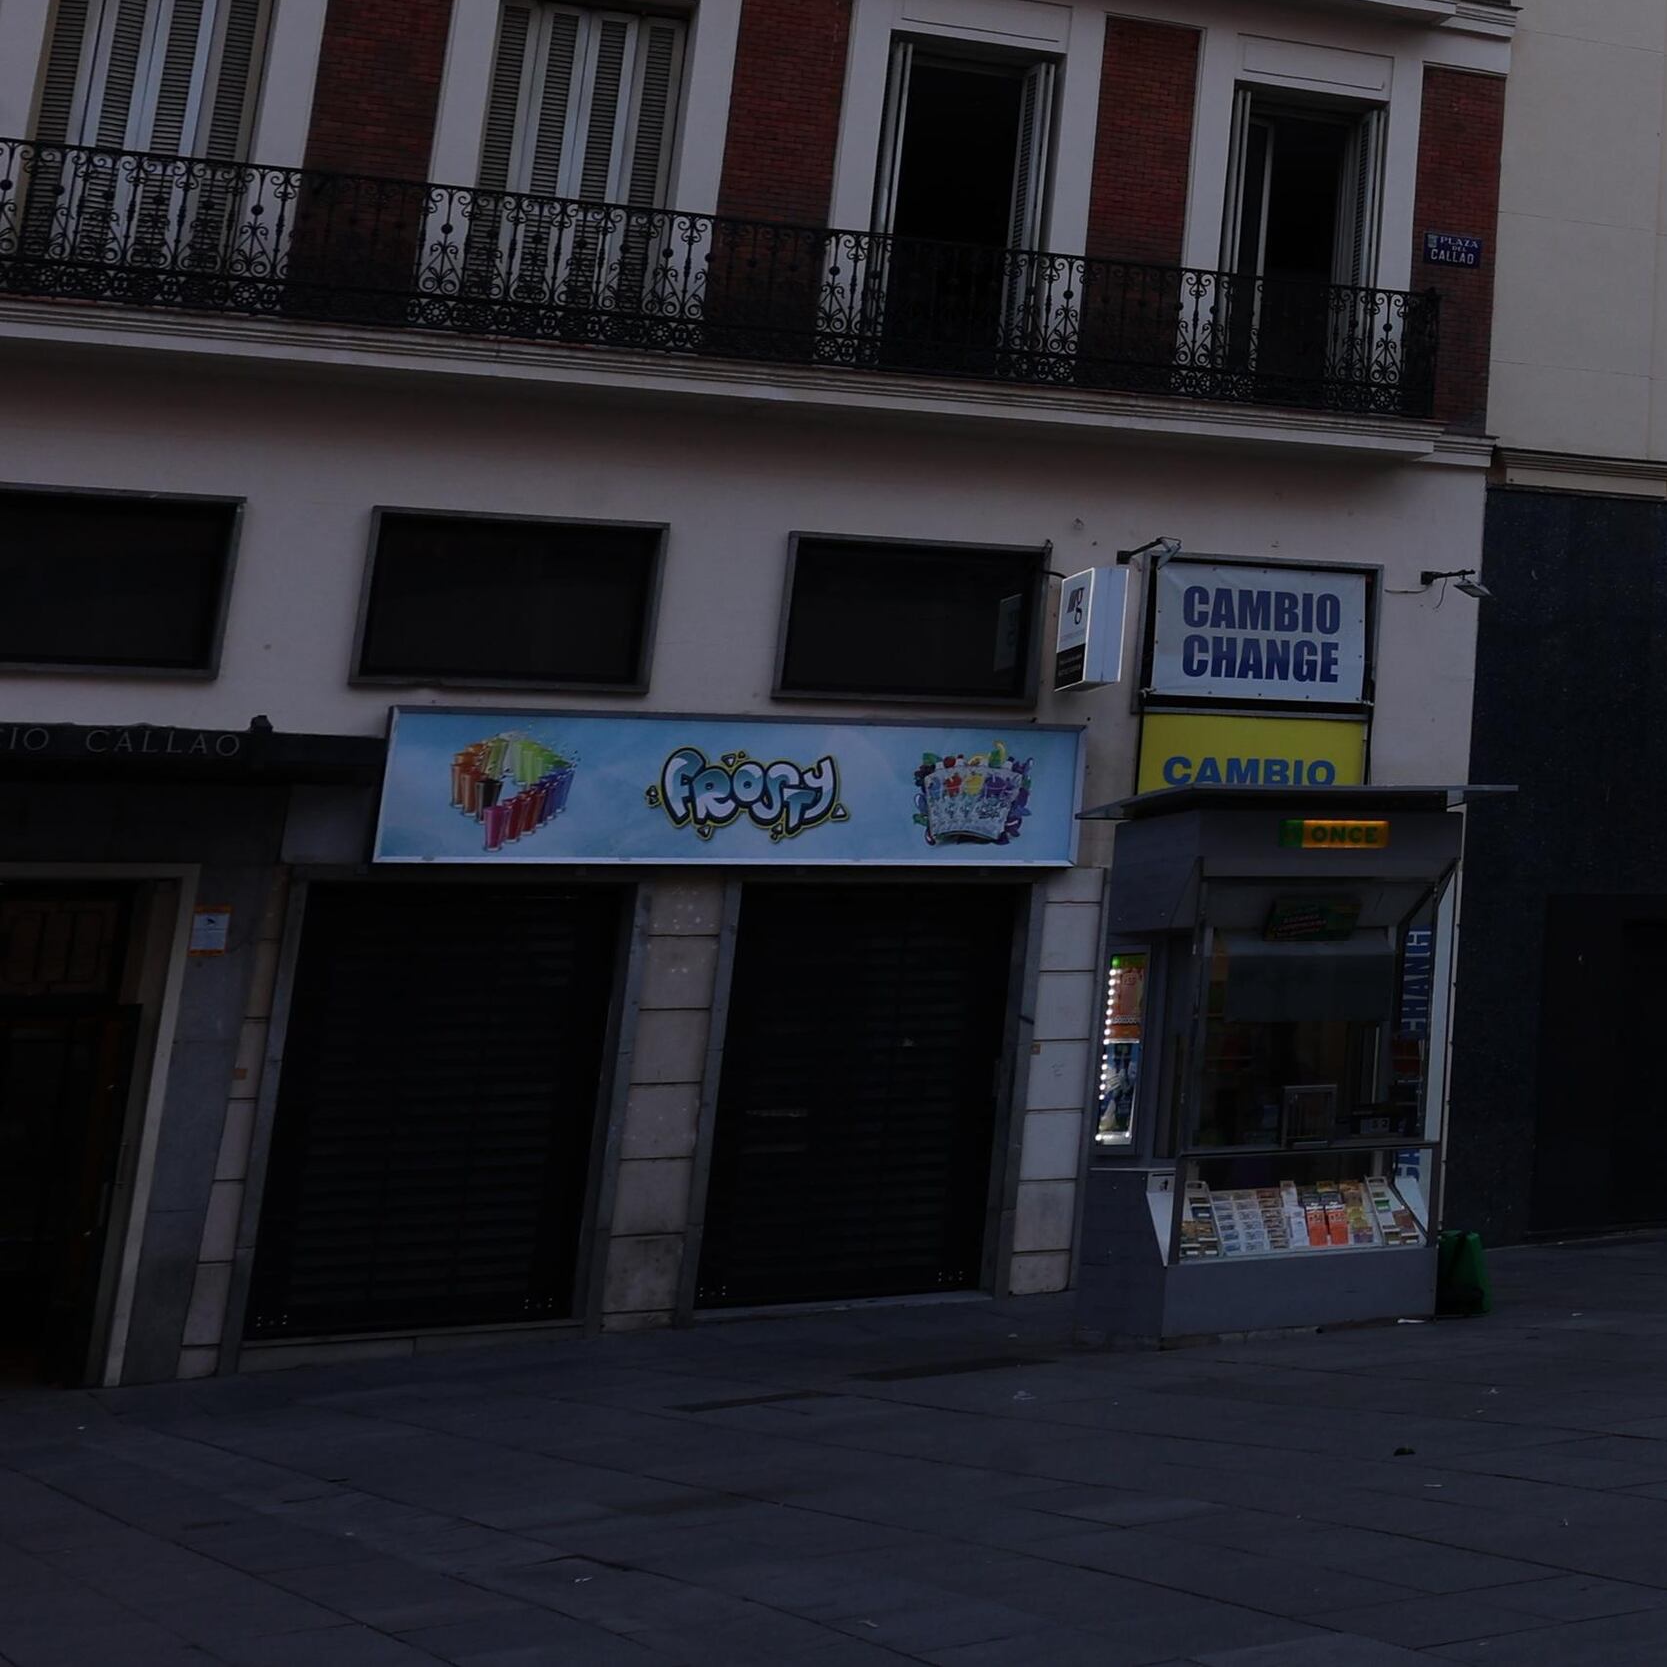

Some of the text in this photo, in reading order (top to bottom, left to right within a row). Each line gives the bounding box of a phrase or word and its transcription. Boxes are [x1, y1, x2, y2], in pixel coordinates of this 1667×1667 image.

[1431, 249, 1475, 265] CALLAO
[1440, 236, 1479, 249] PLAZA
[1183, 586, 1341, 635] CAMBIO
[1182, 635, 1339, 683] CHANGE
[0, 726, 241, 757] IO CALLAO
[1163, 756, 1336, 786] CAMBIO
[1310, 826, 1378, 844] ONCE
